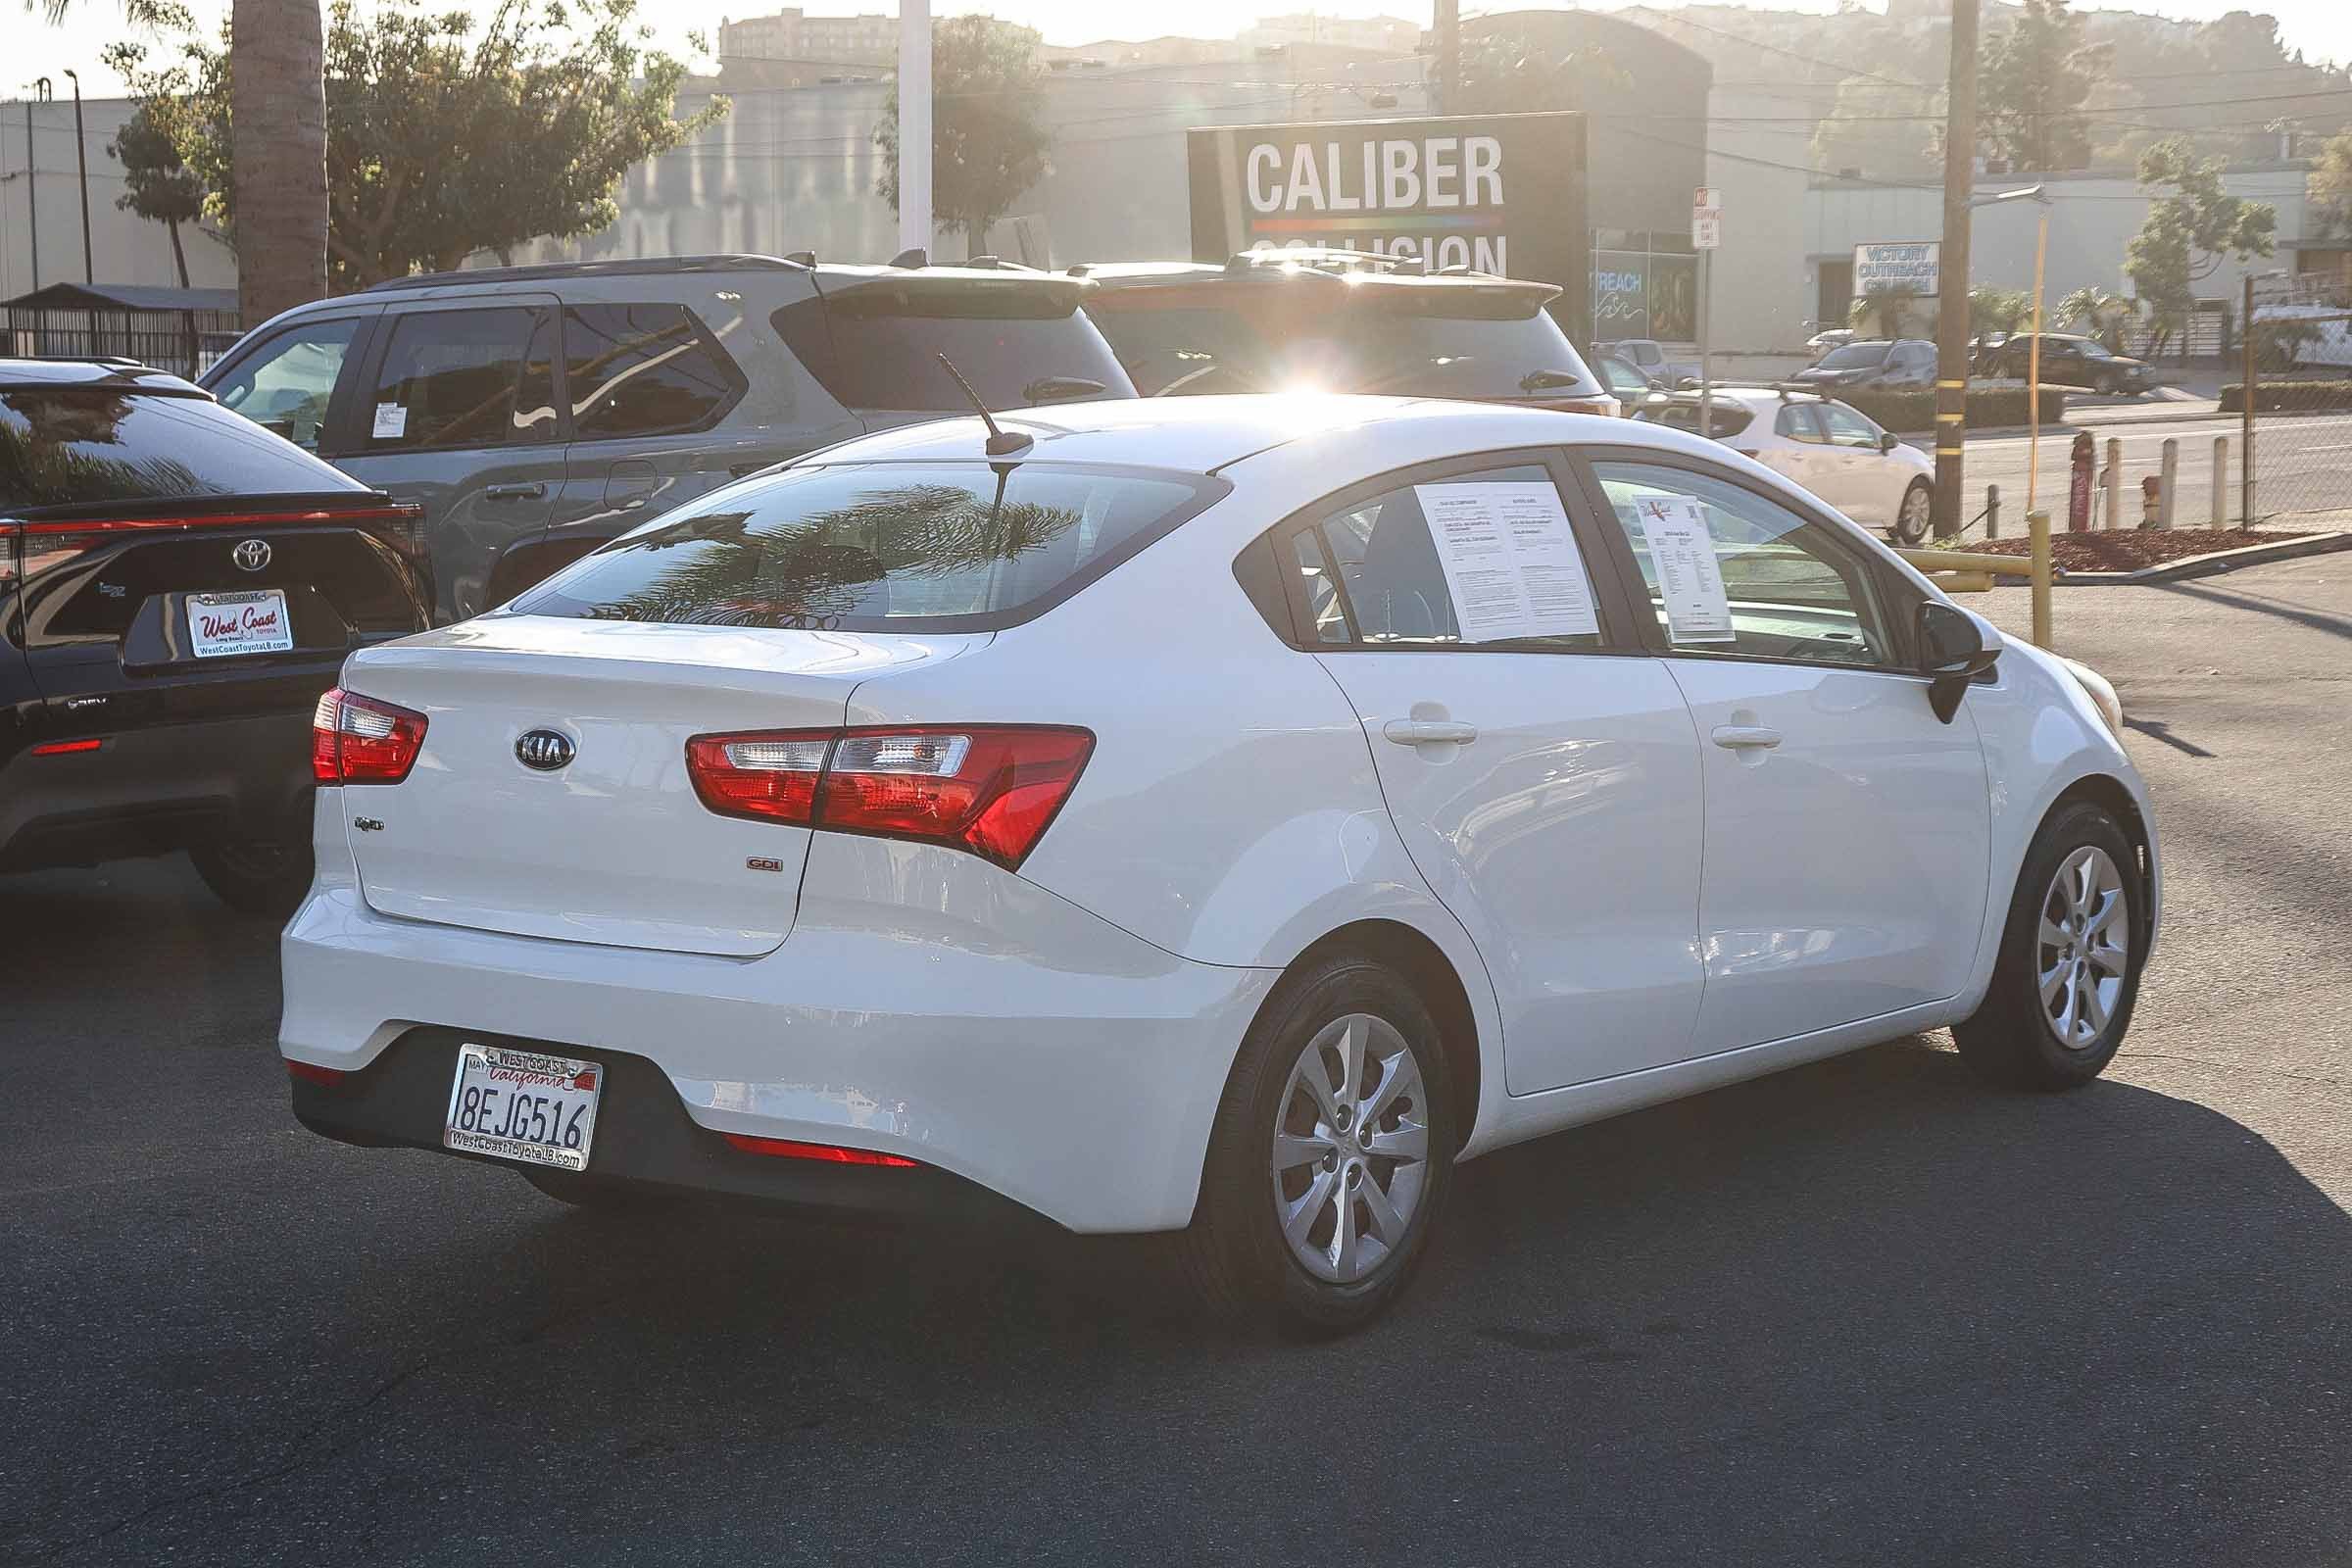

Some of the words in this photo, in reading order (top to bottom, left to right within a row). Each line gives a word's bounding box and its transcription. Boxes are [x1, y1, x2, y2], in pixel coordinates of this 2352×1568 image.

[1246, 136, 1505, 213] CALIBER
[1251, 235, 1506, 278] ISION
[1866, 246, 1930, 261] VICTORY
[1858, 262, 1937, 277] OUTREACH
[1865, 279, 1930, 292] CHUH
[200, 614, 238, 638] West
[242, 607, 277, 629] Coast
[200, 642, 288, 655] WestCoastToyotaLB.com
[521, 737, 562, 761] KIA
[749, 858, 780, 869] GDI
[499, 1052, 527, 1066] WEST
[528, 1056, 565, 1074] COAST
[489, 1066, 573, 1091] California
[460, 1086, 587, 1149] 8EJG516
[450, 1131, 581, 1169] WestCoastToyotaLB.com
